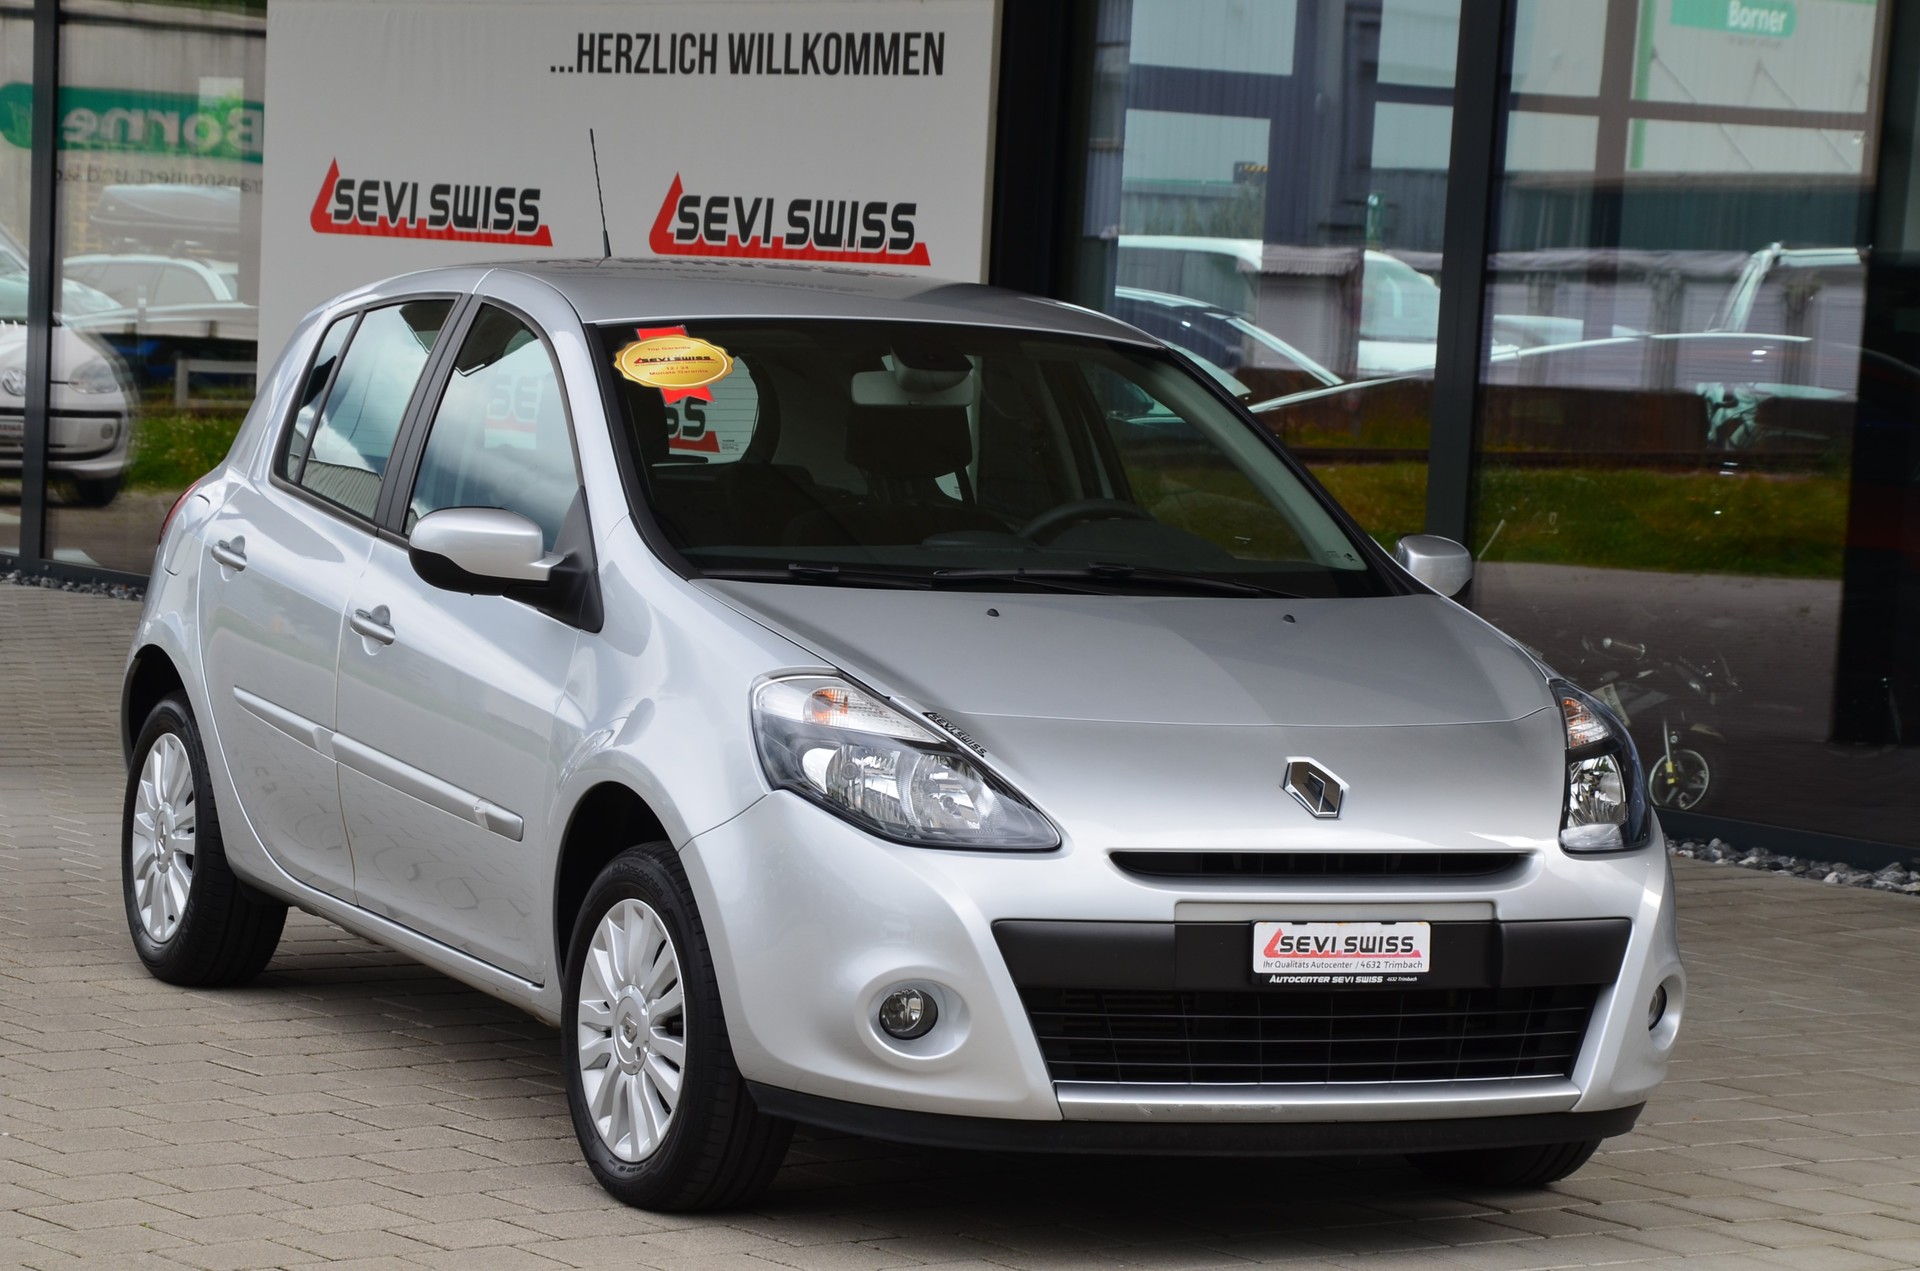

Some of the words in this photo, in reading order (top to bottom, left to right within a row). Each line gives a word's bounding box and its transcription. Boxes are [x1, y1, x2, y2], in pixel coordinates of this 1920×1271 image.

[1727, 0, 1787, 32] Borner
[550, 32, 718, 74] ...HERZLICH
[727, 32, 945, 75] WILLKOMMEN
[331, 178, 417, 227] SEVI
[427, 184, 542, 235] SWISS
[675, 195, 774, 247] SEVI
[784, 199, 917, 251] SWISS
[1279, 936, 1336, 954] SEVI
[1344, 936, 1414, 953] SWISS
[1263, 961, 1274, 969] Ihr
[1310, 961, 1353, 969] Autocenter
[1360, 961, 1381, 969] 4632
[1384, 960, 1423, 969] Trimbach
[1331, 976, 1354, 984] SEVI
[1354, 976, 1383, 984] SWISS
